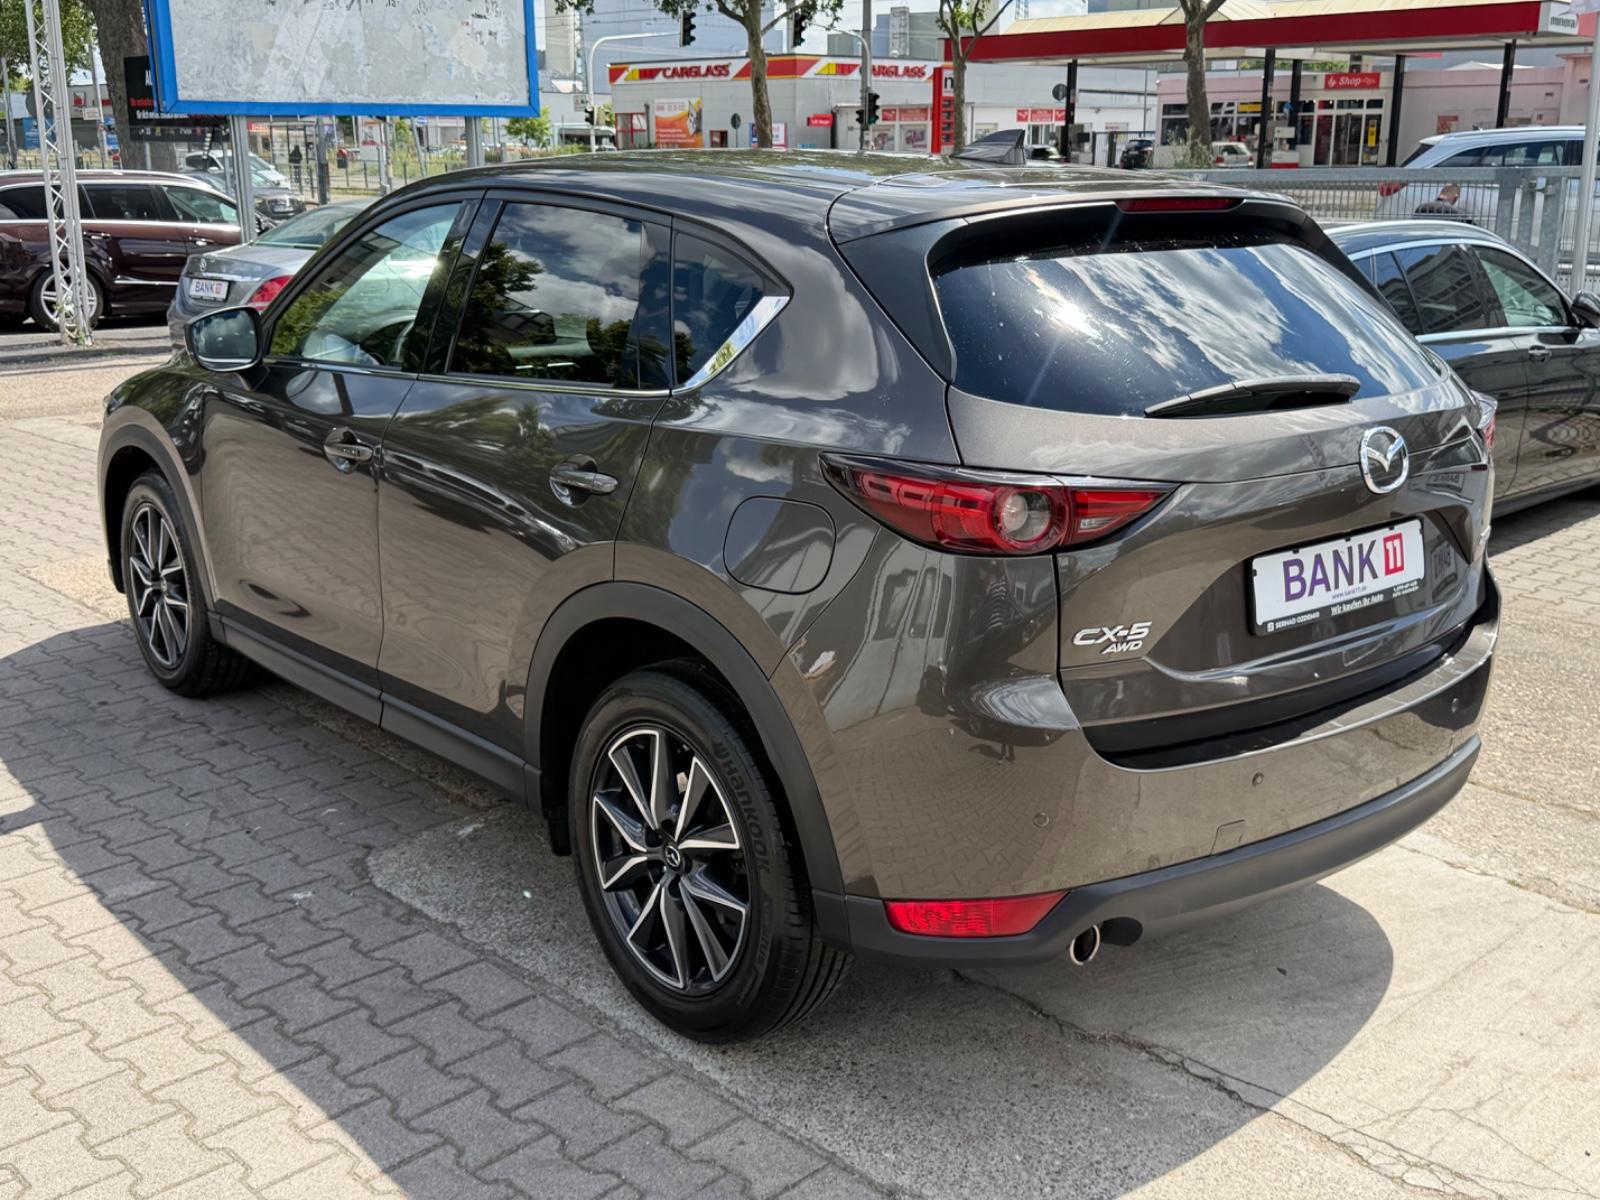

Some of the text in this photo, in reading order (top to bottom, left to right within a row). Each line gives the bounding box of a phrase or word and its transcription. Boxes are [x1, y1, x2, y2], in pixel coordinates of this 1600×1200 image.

[662, 64, 730, 79] CARGLASS
[860, 64, 926, 79] ARGLASS
[1338, 75, 1360, 88] Shop
[194, 280, 214, 294] BANK
[1283, 536, 1403, 603] BANK 11
[1330, 604, 1342, 617] Wir
[1342, 598, 1363, 612] kaufen
[1370, 593, 1384, 604] Auto
[1073, 620, 1153, 646] CX-5
[1100, 640, 1143, 655] AWD
